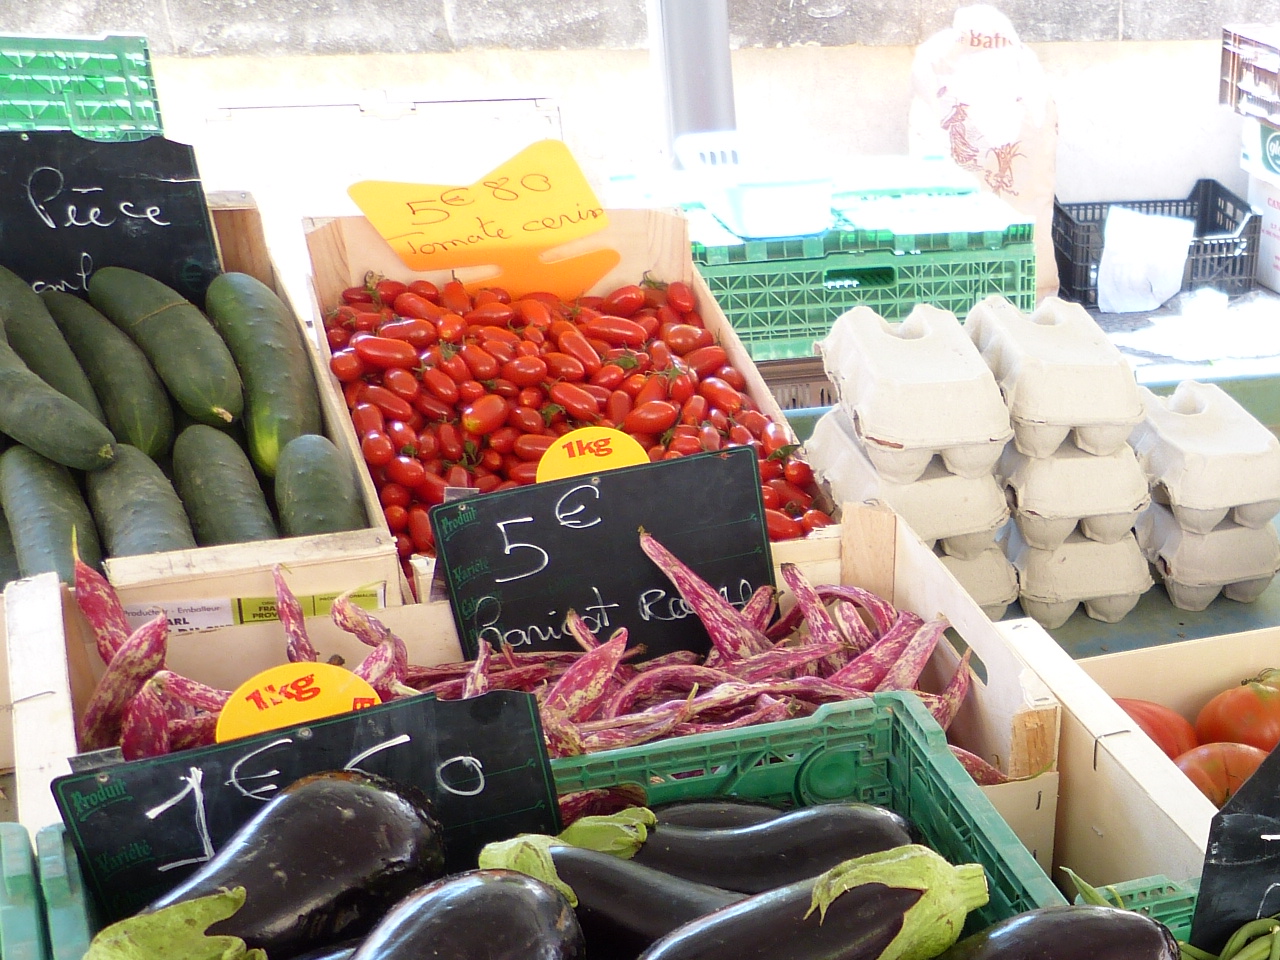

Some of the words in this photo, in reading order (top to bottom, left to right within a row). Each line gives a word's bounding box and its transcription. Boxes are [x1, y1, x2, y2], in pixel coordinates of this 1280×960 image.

[562, 437, 613, 459] 1kg
[123, 607, 168, 617] Producter
[177, 605, 221, 614] Emballeur
[167, 617, 190, 626] ARL
[246, 673, 321, 711] 1kg
